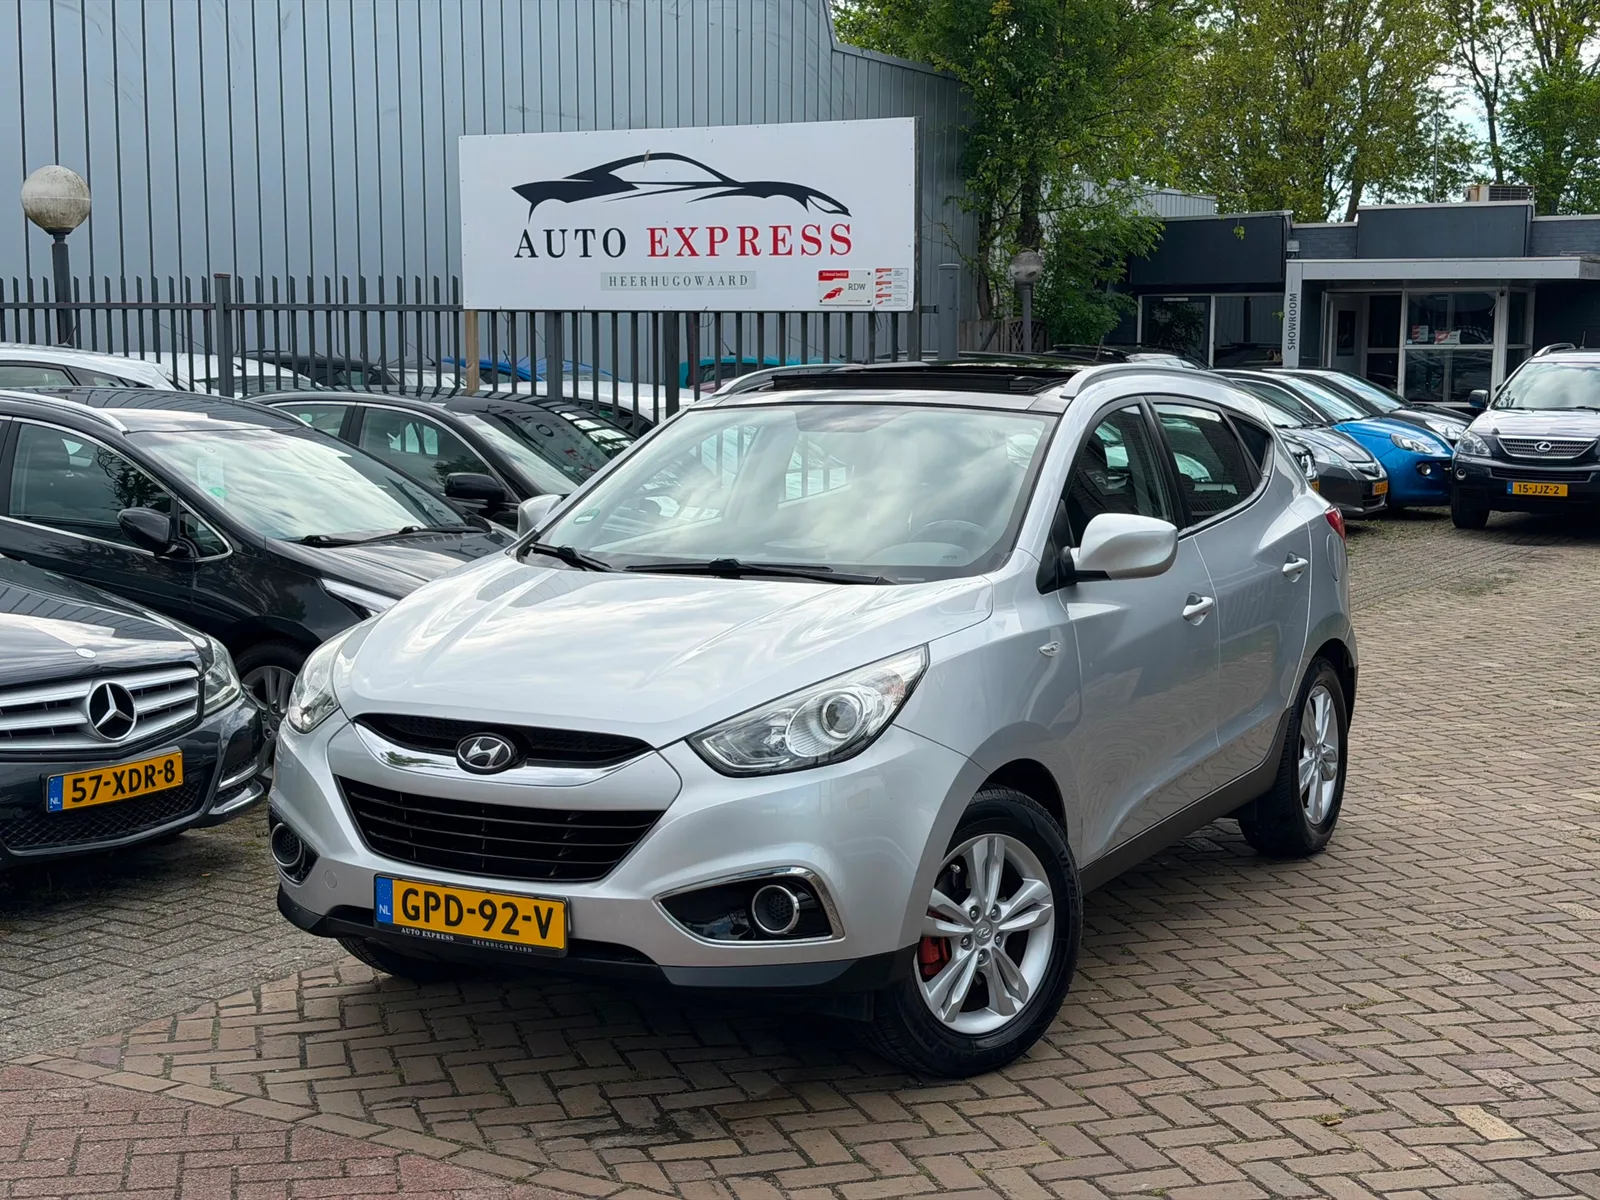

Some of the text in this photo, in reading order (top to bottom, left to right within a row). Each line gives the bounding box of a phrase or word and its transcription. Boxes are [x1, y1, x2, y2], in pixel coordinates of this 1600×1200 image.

[513, 223, 853, 259] AUTO EXPRESS
[607, 273, 750, 288] HEERHUGOWAARD
[848, 283, 866, 291] RDW
[1287, 292, 1298, 351] SHOWROOM
[1517, 483, 1561, 495] 15-JJZ-2
[71, 758, 176, 803] 57-XDR-8
[50, 796, 61, 805] NL
[378, 904, 392, 916] NL
[401, 887, 554, 940] GPD-92-V
[401, 927, 533, 953] AUTO EXPRESS HEERHUGOWAARD
